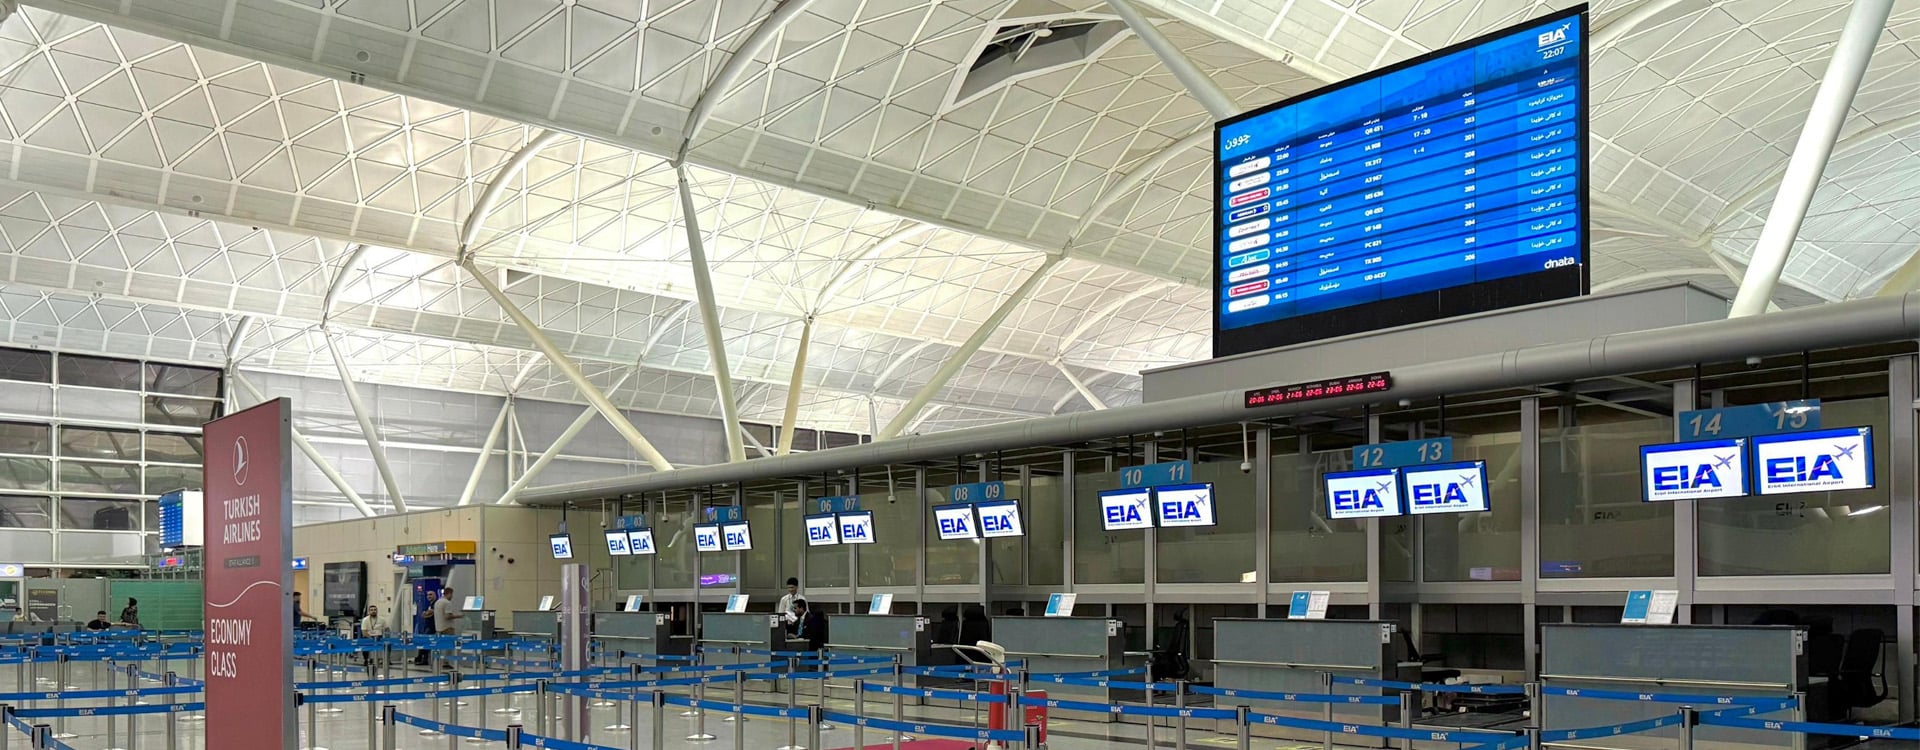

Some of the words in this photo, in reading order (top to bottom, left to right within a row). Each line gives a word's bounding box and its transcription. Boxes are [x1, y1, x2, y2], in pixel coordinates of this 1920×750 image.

[1539, 28, 1566, 48] EIA
[1543, 47, 1564, 59] 22:07
[1544, 256, 1574, 269] dnata
[1690, 412, 1721, 436] 14
[1773, 408, 1807, 430] 15
[1360, 448, 1384, 467] 12
[1418, 442, 1442, 462] 13
[1125, 469, 1141, 485] 10
[1169, 464, 1184, 480] 11
[1767, 454, 1843, 483] EIA
[1654, 464, 1721, 490] EIA
[955, 487, 968, 500] 08
[985, 484, 1000, 498] 09
[1334, 489, 1384, 509] EIA
[1413, 483, 1467, 505] EIA
[224, 494, 260, 520] TURKISH
[821, 500, 831, 512] 06
[845, 498, 856, 510] 07
[1162, 501, 1200, 519] EIA
[728, 508, 738, 519] 05
[1106, 505, 1141, 522] EIA
[843, 524, 866, 537] EIA
[940, 518, 968, 533] EIA
[983, 515, 1012, 531] EIA
[224, 520, 261, 544] AIRLINES
[726, 533, 745, 545] EIA
[810, 526, 831, 540] EIA
[610, 540, 625, 550] EIA
[632, 539, 649, 550] EIA
[698, 535, 715, 546] EIA
[554, 544, 568, 554] EIA
[211, 619, 251, 645] ECONOMY
[211, 652, 236, 678] CLASS
